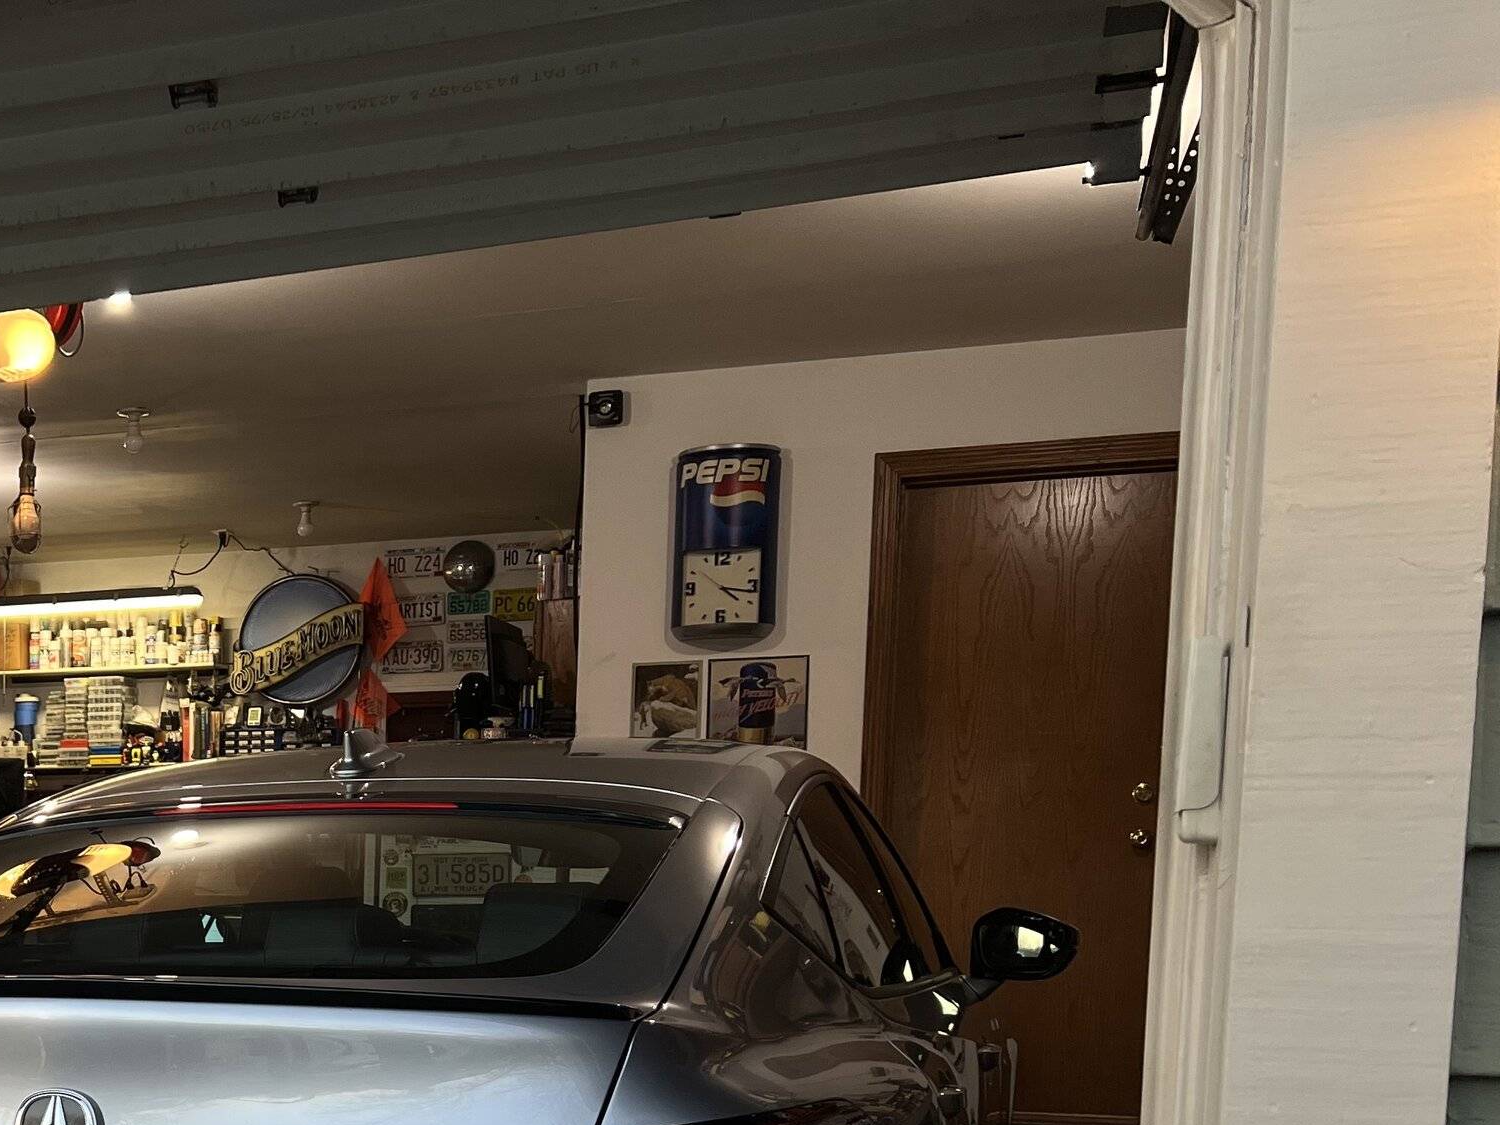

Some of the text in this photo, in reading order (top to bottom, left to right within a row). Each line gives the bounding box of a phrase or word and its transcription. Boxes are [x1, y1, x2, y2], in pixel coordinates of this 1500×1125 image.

[680, 458, 770, 489] PEPSI
[415, 554, 441, 572] Z24
[526, 549, 540, 565] Z2
[713, 551, 732, 567] 12
[685, 579, 759, 597] 9 3
[517, 596, 535, 613] 66
[715, 609, 727, 624] 6
[230, 609, 362, 694] BLUE MOON
